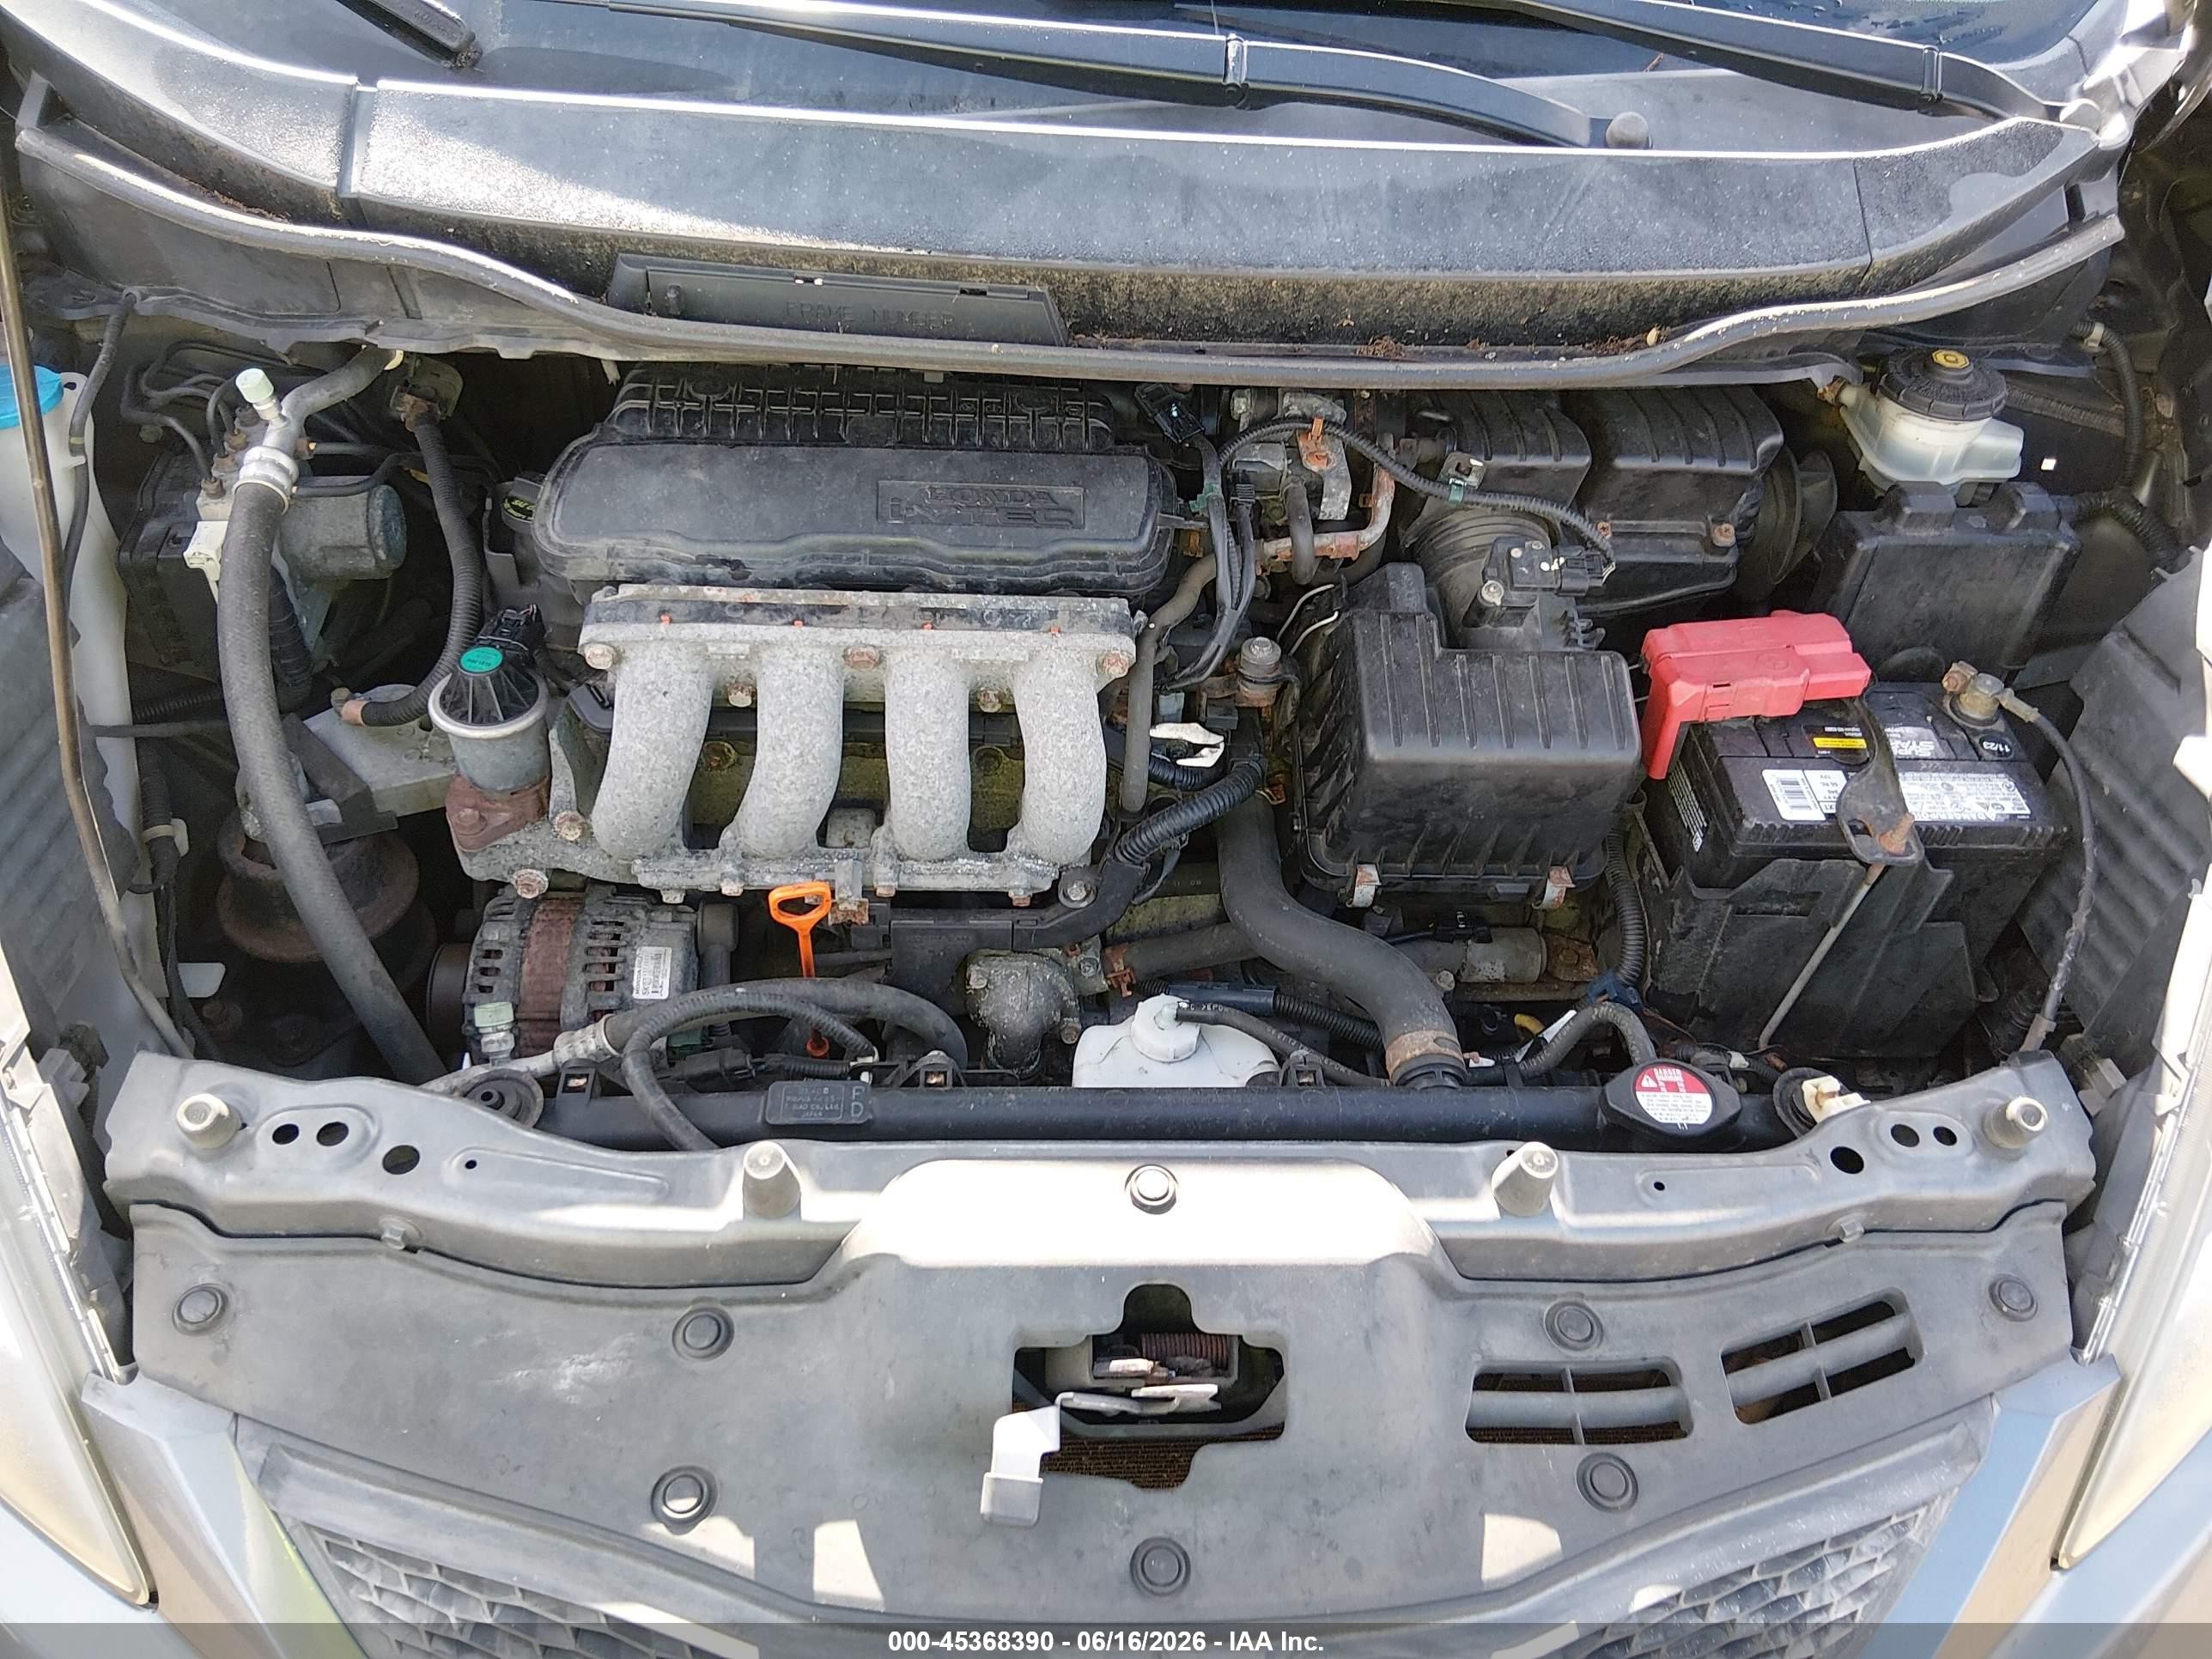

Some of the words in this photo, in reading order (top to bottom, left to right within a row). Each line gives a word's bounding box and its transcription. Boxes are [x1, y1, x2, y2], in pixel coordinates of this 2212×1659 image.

[786, 301, 854, 323] FRAME
[872, 308, 956, 331] NUMBER
[922, 486, 1059, 507] HONDA
